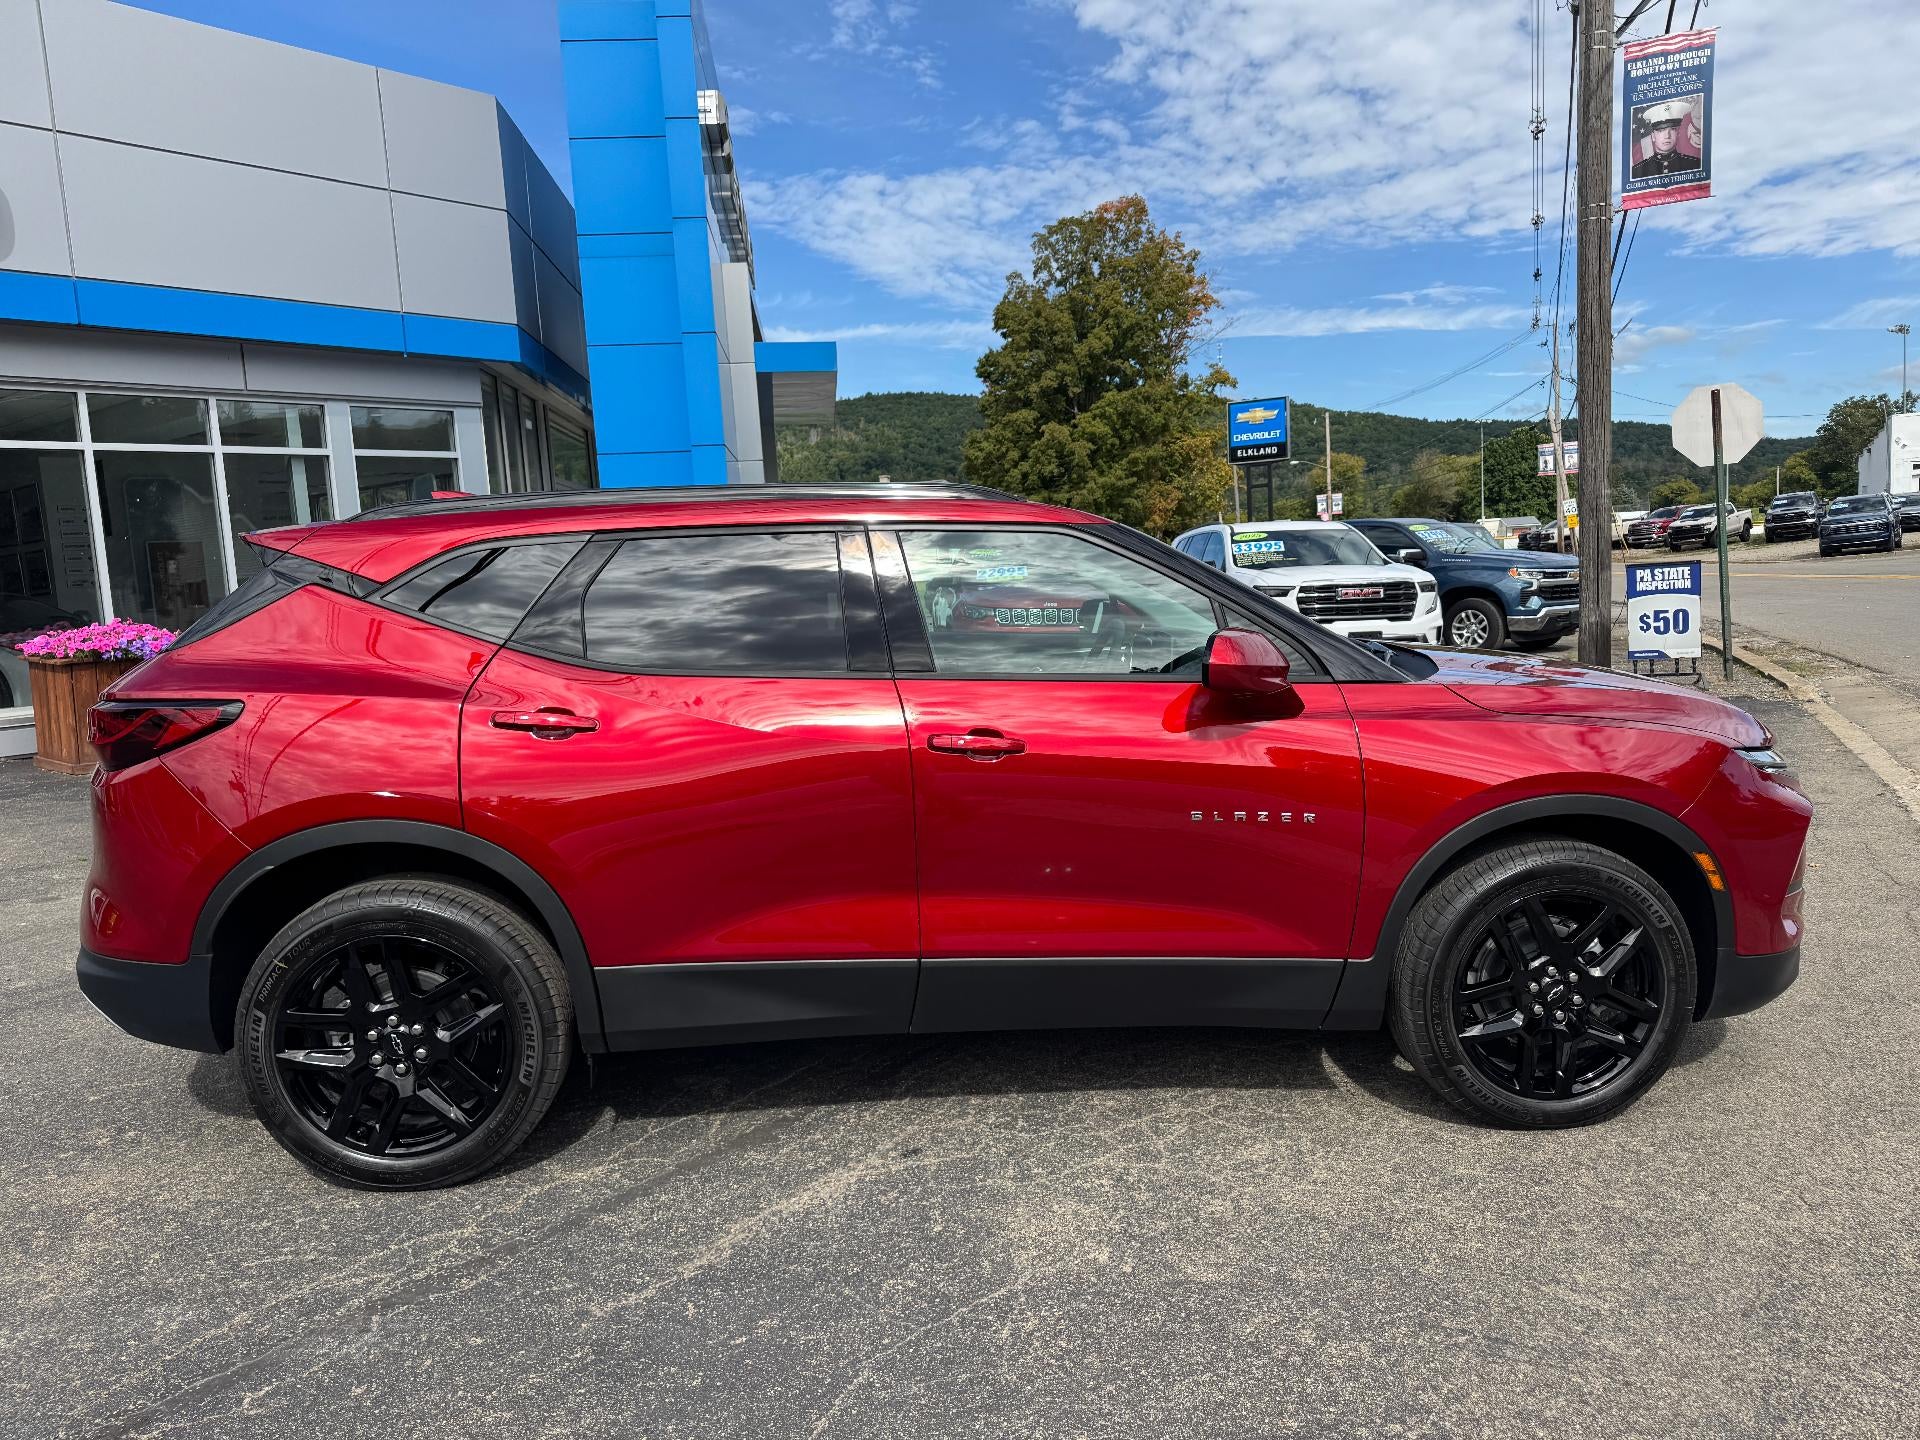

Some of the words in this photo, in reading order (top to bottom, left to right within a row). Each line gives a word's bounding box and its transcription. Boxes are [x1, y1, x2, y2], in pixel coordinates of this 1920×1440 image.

[1627, 56, 1665, 71] ELKLAND
[1667, 48, 1711, 63] BOROUGH
[1630, 62, 1680, 78] HOMETOWN
[1682, 56, 1707, 68] HERO
[1637, 79, 1672, 92] MICHAEL
[1673, 73, 1698, 85] PLANK
[1646, 86, 1677, 99] MARINE
[1678, 82, 1703, 93] CORPS
[1233, 429, 1281, 442] CHEVROLET
[1237, 446, 1278, 457] ELKLAND
[1565, 506, 1577, 514] 40
[1234, 541, 1282, 553] 33995
[1636, 568, 1652, 582] PA
[1653, 566, 1691, 580] STATE
[1341, 588, 1382, 599] GMC
[1636, 578, 1692, 592] INSPECTION
[1638, 608, 1690, 635] $50
[1190, 810, 1316, 824] BLAZER
[1604, 875, 1667, 925] MICHELIN
[286, 938, 312, 961] TOUR
[516, 1001, 537, 1083] MICHELIN
[248, 1013, 270, 1096] MICHELIN
